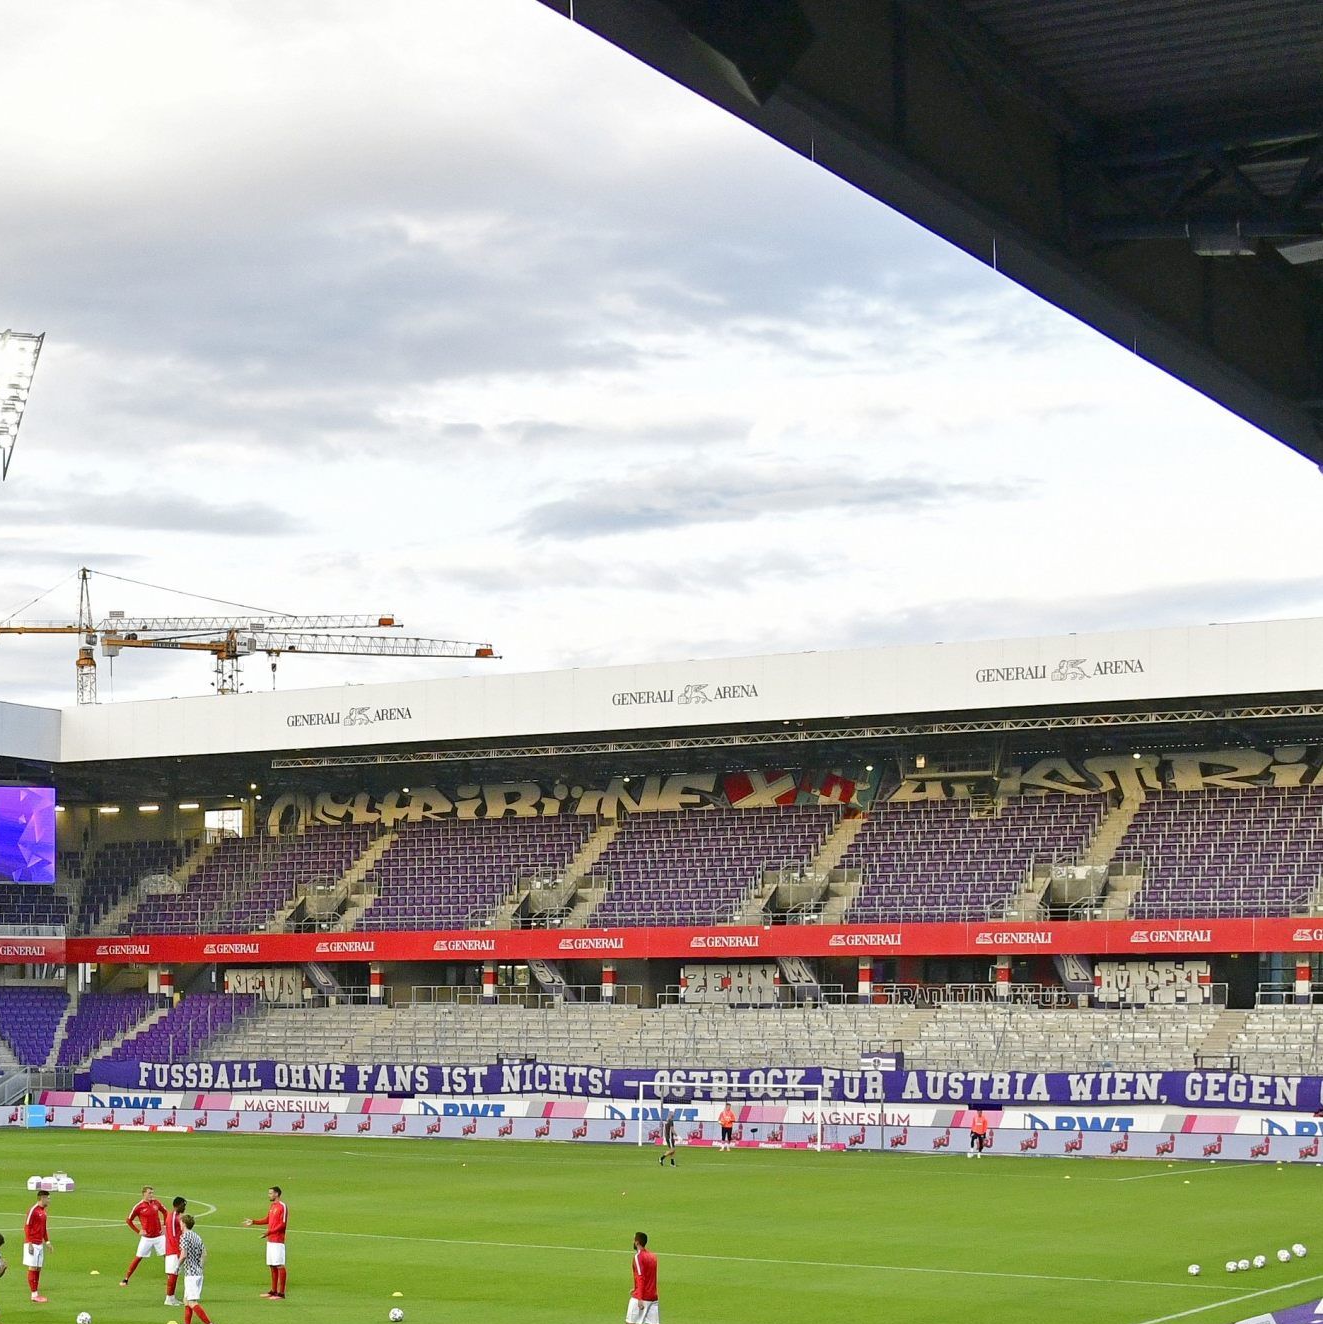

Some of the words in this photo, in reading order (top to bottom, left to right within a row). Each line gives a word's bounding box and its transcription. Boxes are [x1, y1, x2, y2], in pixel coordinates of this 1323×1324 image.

[975, 664, 1047, 684] GENERALI
[1093, 658, 1144, 677] ARENA
[612, 689, 674, 706] GENERALI
[714, 684, 758, 701] ARENA
[286, 711, 341, 727] GENERALI
[374, 707, 412, 722] ARENA
[706, 935, 759, 947] GENERALI
[846, 933, 901, 946] GENERALI
[993, 932, 1052, 944] GENERALI
[1149, 930, 1211, 942] GENERALI
[216, 943, 259, 954] GENERALI
[329, 941, 375, 953] GENERALI
[447, 939, 495, 951] GENERALI
[574, 937, 624, 949] GENERALI
[0, 945, 45, 957] GENERALI
[108, 944, 150, 956] GENERALI
[138, 1061, 262, 1089] FUSSBALL
[275, 1063, 345, 1091] OHNE
[357, 1064, 429, 1092] FANS
[441, 1066, 488, 1093] IST
[500, 1064, 612, 1095] NICHTS!
[654, 1070, 805, 1099] OSTBLOCK
[821, 1068, 885, 1100] FÜR
[902, 1071, 1050, 1101] AUSTRIA
[1067, 1072, 1169, 1104] WIEN,
[1184, 1072, 1302, 1106] GEGEN
[244, 1099, 330, 1112] MAGNESIUM
